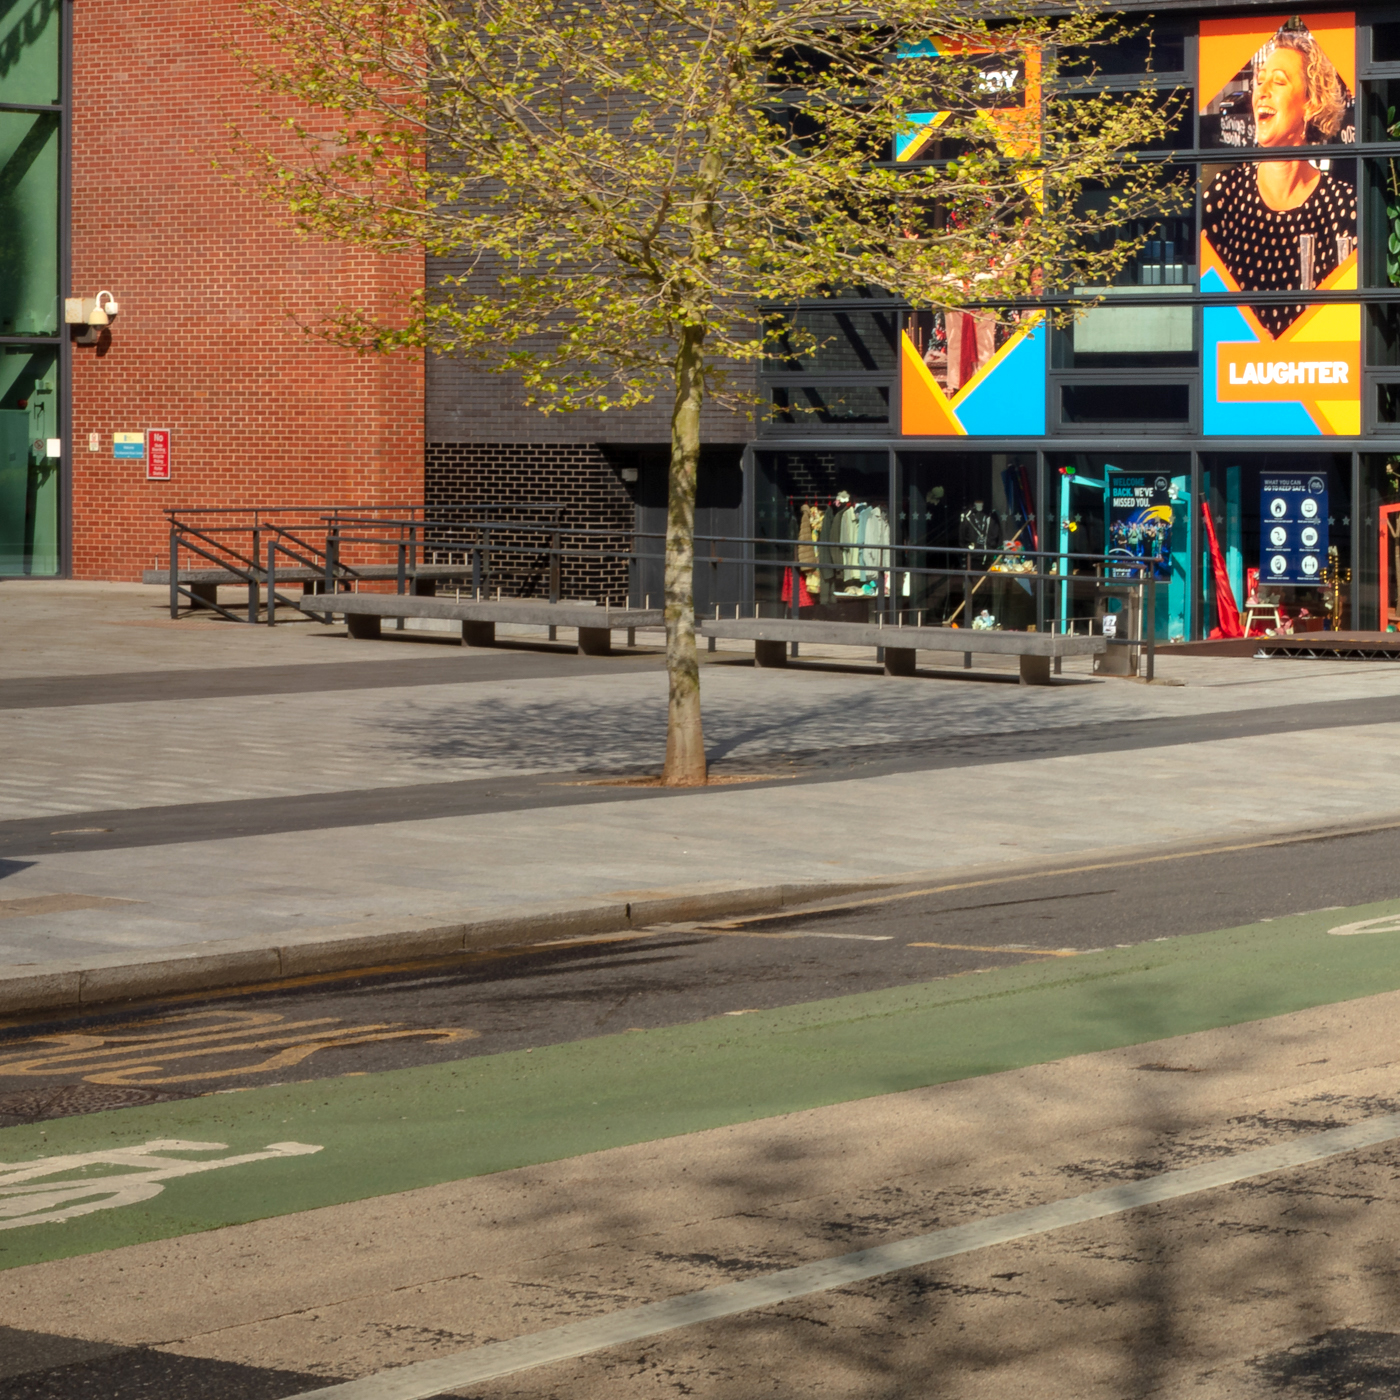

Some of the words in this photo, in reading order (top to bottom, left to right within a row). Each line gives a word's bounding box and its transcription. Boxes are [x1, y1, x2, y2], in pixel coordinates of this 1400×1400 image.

[1229, 360, 1349, 386] LAUGHTER
[153, 433, 164, 442] No
[1113, 477, 1145, 487] WELCOME
[1113, 498, 1135, 507] MISSED
